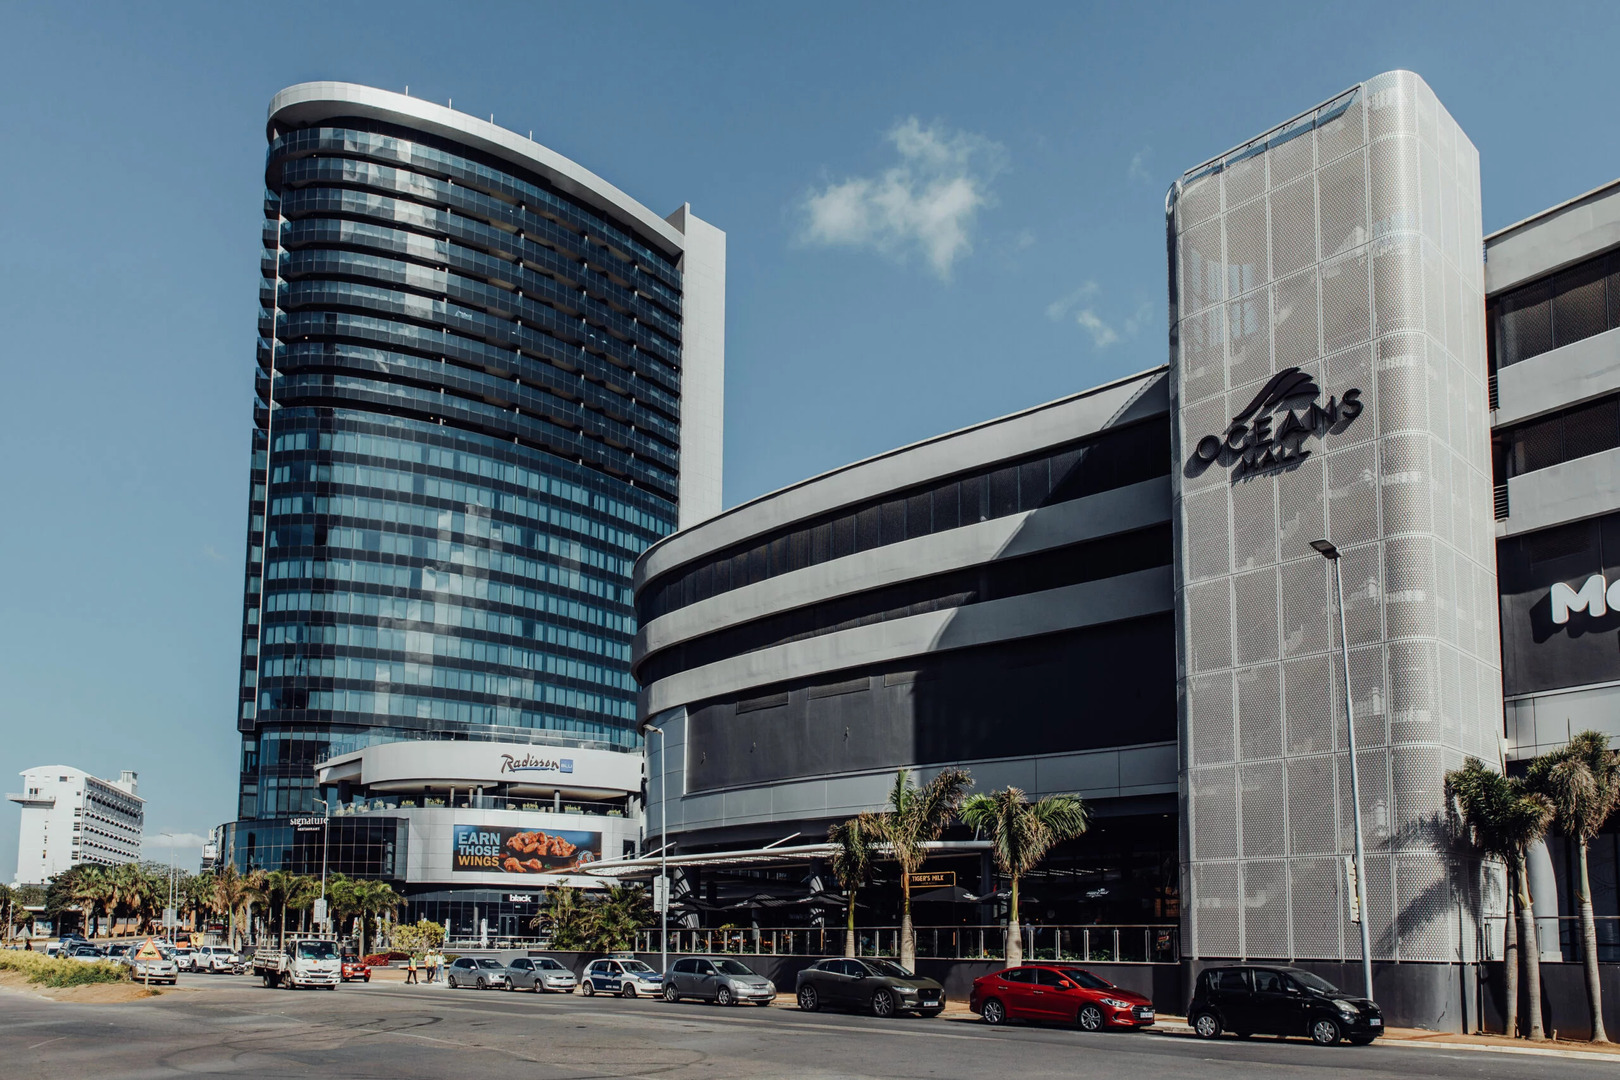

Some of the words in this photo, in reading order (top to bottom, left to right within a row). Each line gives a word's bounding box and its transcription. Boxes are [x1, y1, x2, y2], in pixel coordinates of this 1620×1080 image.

[1196, 387, 1365, 462] OCEANS
[1241, 439, 1312, 474] MALL
[501, 753, 560, 774] Radisson
[290, 817, 330, 828] signature
[458, 832, 501, 846] EARN
[458, 845, 500, 857] THOSE
[458, 856, 500, 867] WINGS
[932, 874, 945, 882] MILK
[509, 894, 532, 902] black
